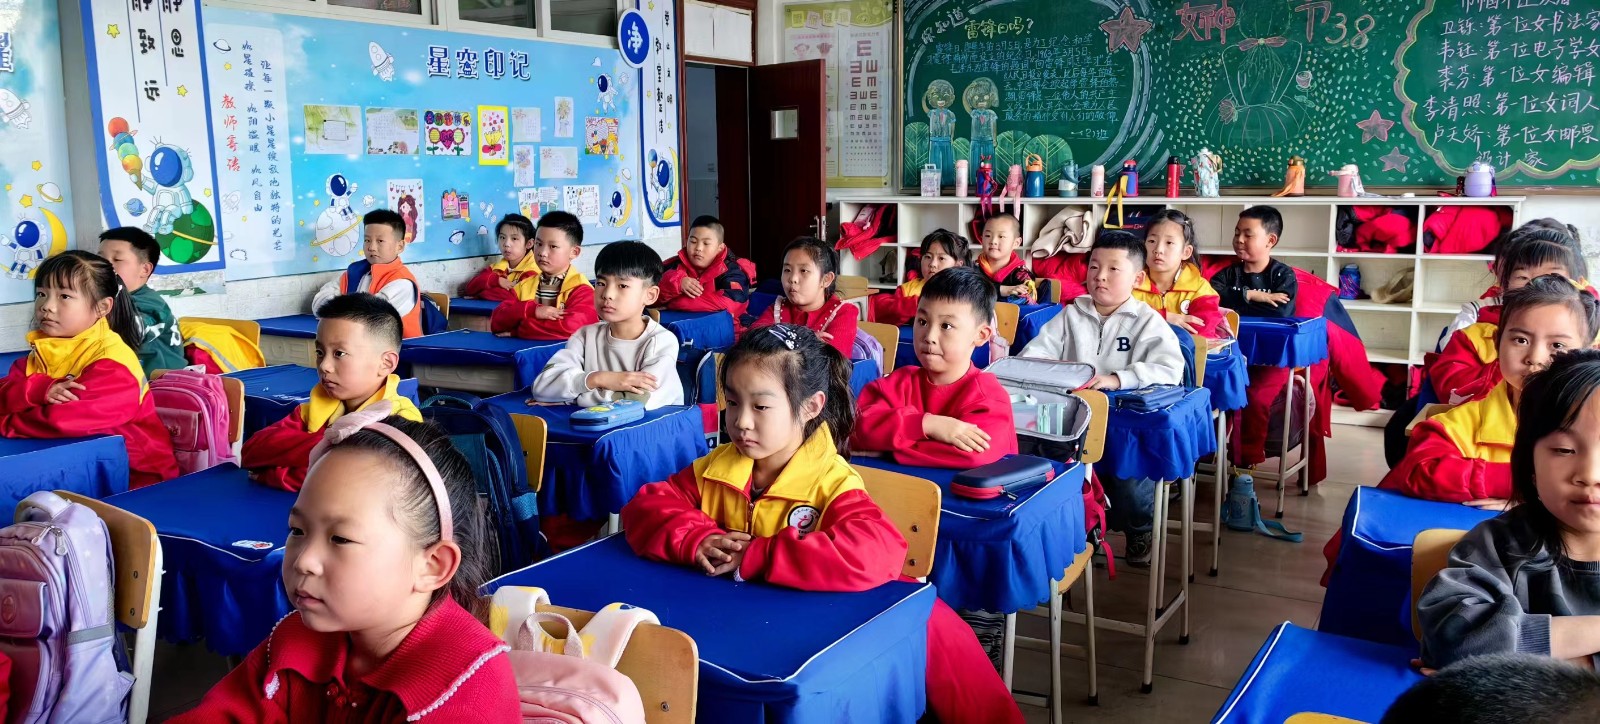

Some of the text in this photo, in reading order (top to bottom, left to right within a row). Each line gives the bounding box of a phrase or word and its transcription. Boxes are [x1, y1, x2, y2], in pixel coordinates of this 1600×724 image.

[627, 21, 643, 54] 净
[1172, 1, 1236, 45] 女神
[426, 44, 531, 80] 星空印记
[221, 94, 240, 172] 教师寄语
[1116, 337, 1131, 351] B
